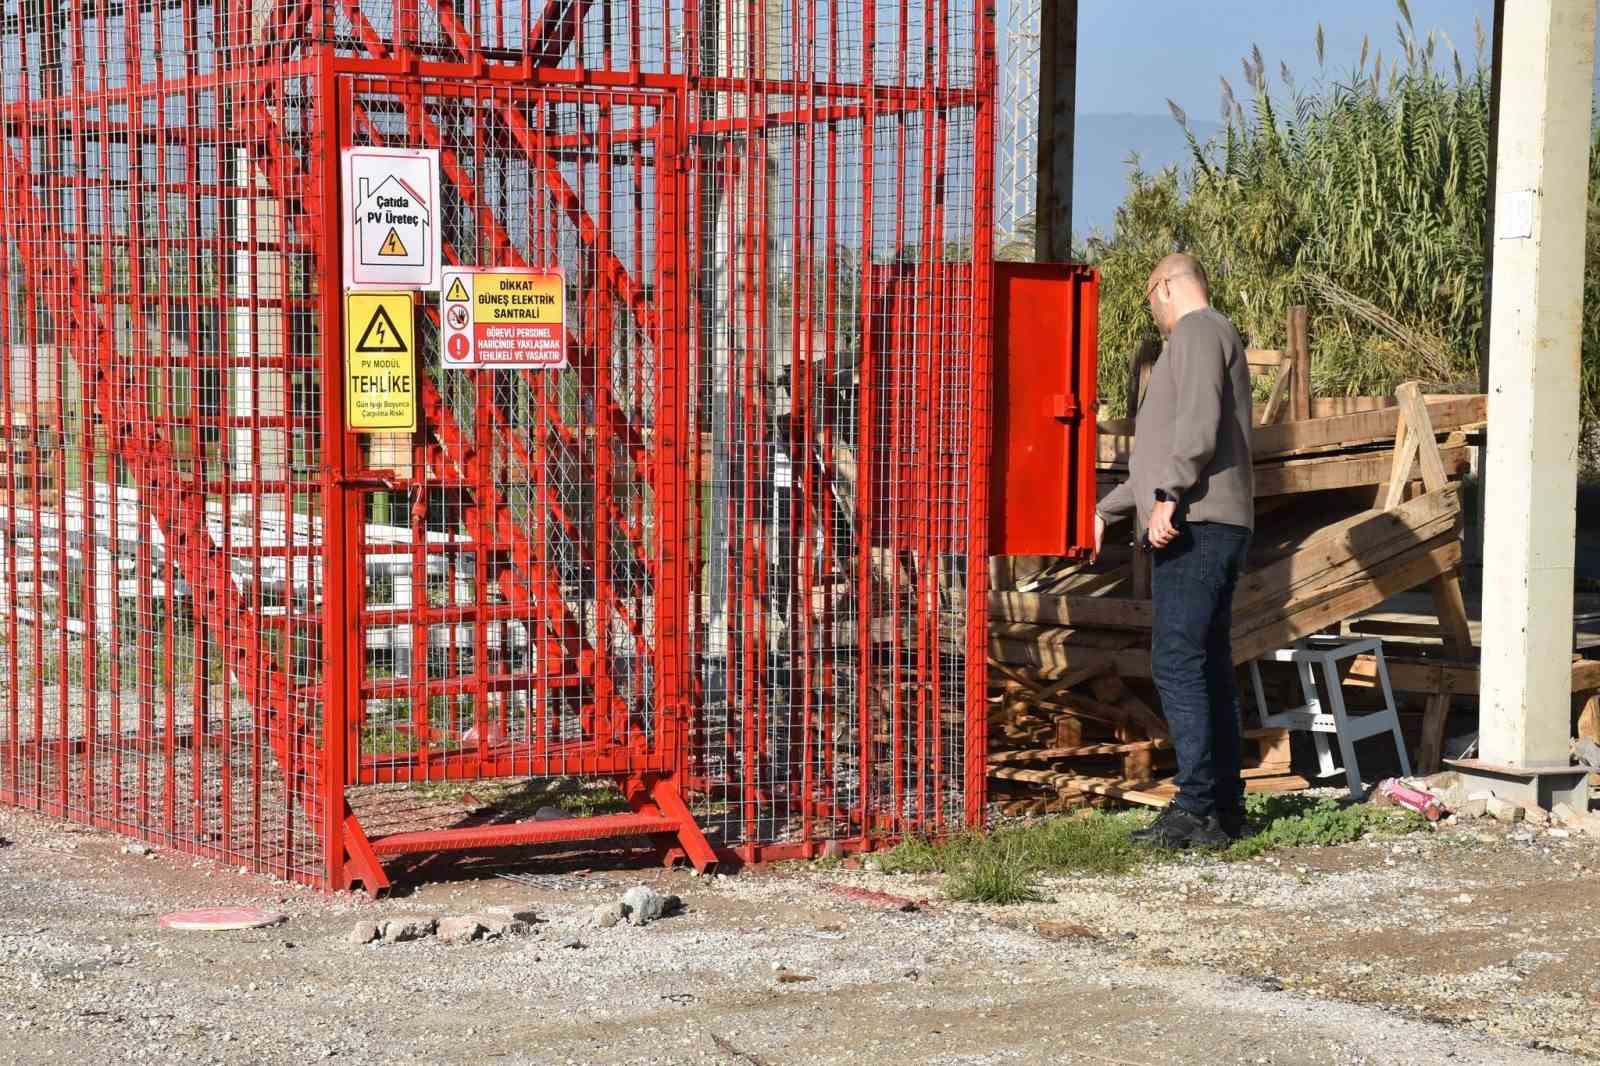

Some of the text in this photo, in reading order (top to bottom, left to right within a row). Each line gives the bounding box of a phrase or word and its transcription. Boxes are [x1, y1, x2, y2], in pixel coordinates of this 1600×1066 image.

[376, 195, 409, 209] Çatıda
[368, 210, 419, 227] PV Üreteç
[499, 278, 534, 291] DİKKAT
[478, 292, 555, 307] GÜNEŞ ELEKTRİK
[493, 307, 540, 319] SANTRALİ
[515, 352, 524, 361] VE
[361, 359, 400, 368] PV MODÜL
[352, 371, 410, 393] TEHLİKE
